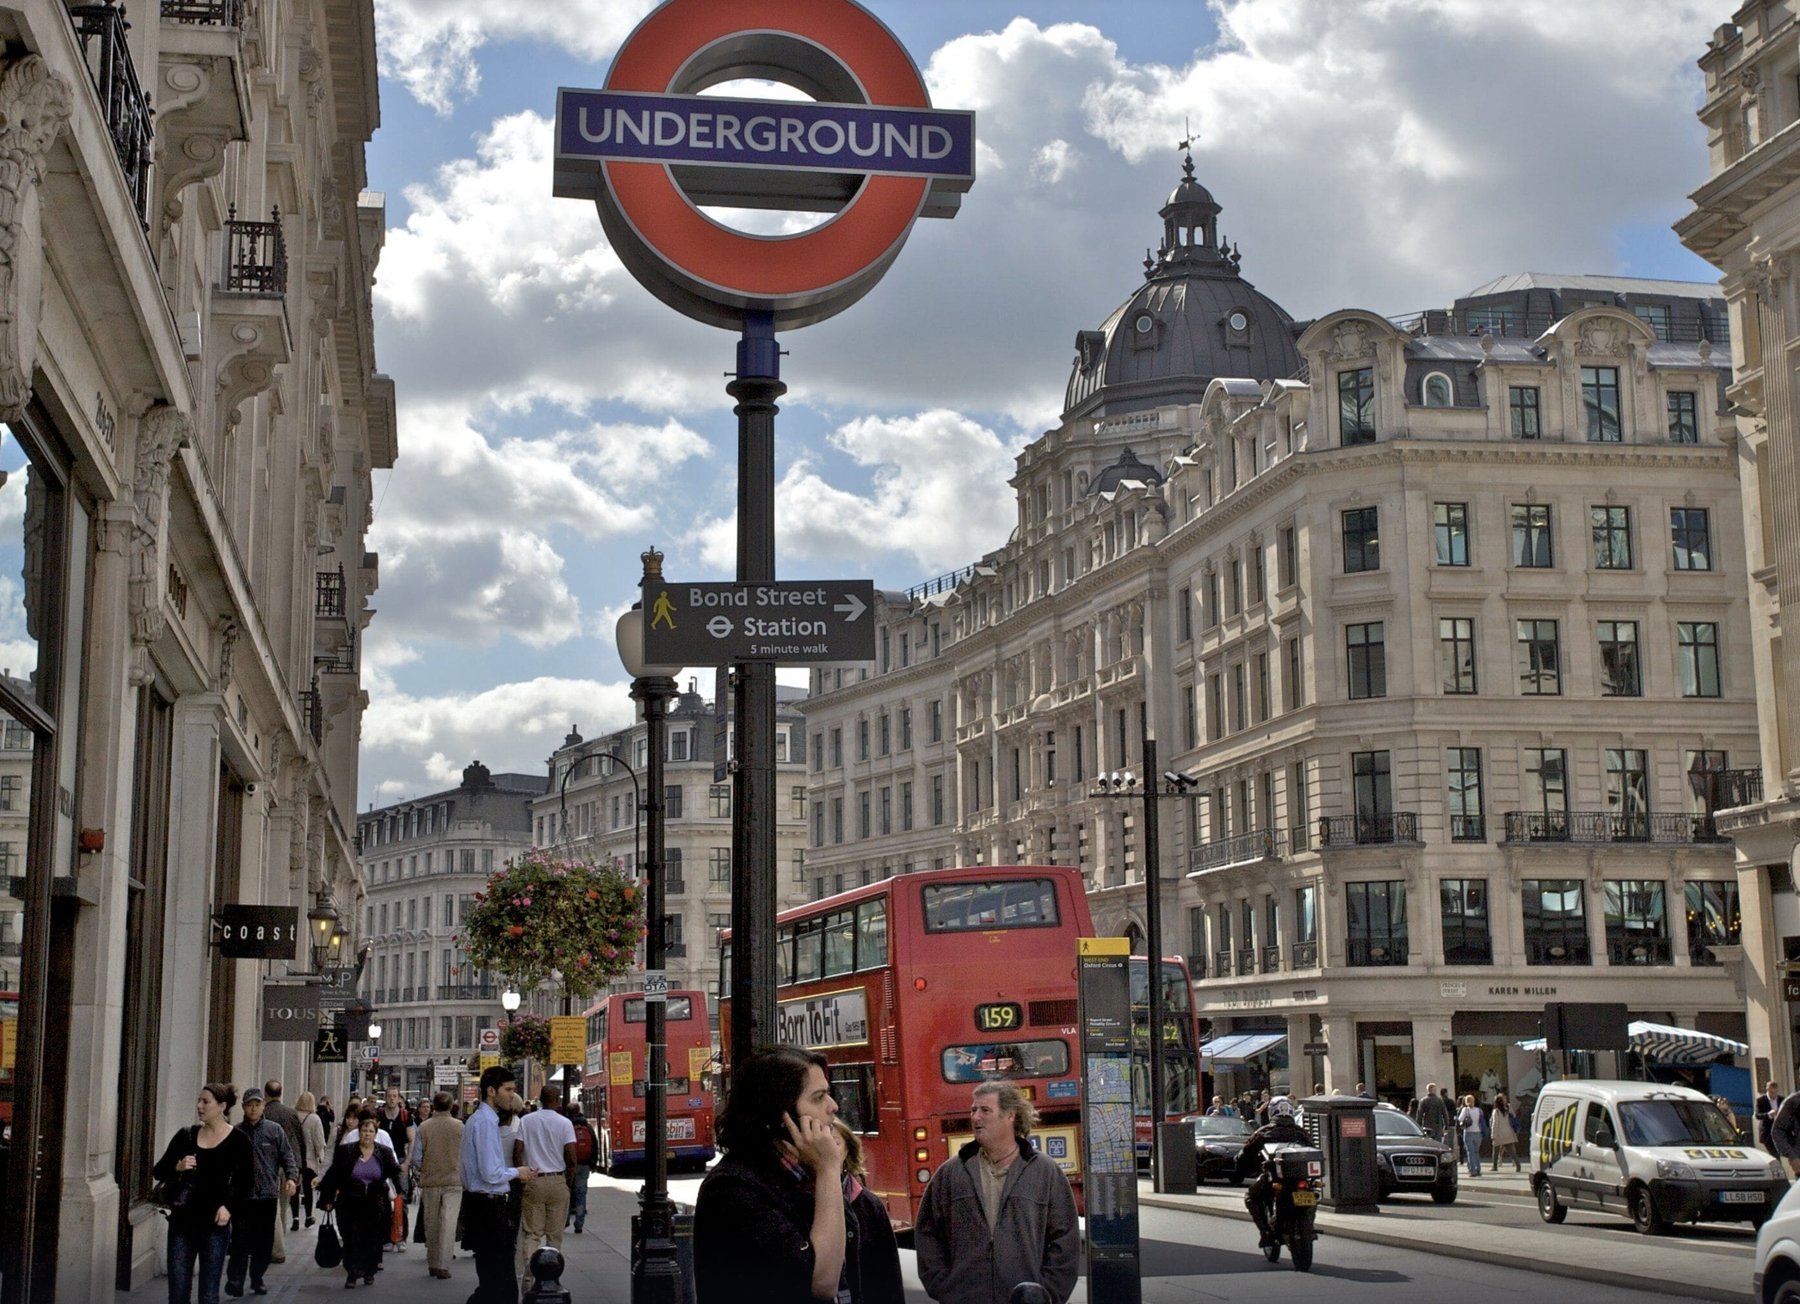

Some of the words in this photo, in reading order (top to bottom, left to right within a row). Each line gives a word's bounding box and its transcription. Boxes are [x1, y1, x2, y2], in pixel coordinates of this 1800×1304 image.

[578, 106, 953, 160] UNDERGROUND
[689, 587, 748, 607] Bond
[756, 586, 827, 606] Street
[743, 617, 827, 637] Station
[750, 644, 757, 654] 5
[760, 644, 800, 654] minute
[802, 643, 828, 654] walk
[223, 924, 295, 941] coast
[1488, 987, 1519, 995] KAREN
[1524, 987, 1557, 995] MILLEN
[267, 1007, 316, 1020] TOUS
[984, 1007, 1014, 1028] 159
[320, 1030, 341, 1053] A
[1540, 1105, 1578, 1165] CYC
[1687, 1150, 1747, 1160] CYC
[1310, 1163, 1319, 1174] L
